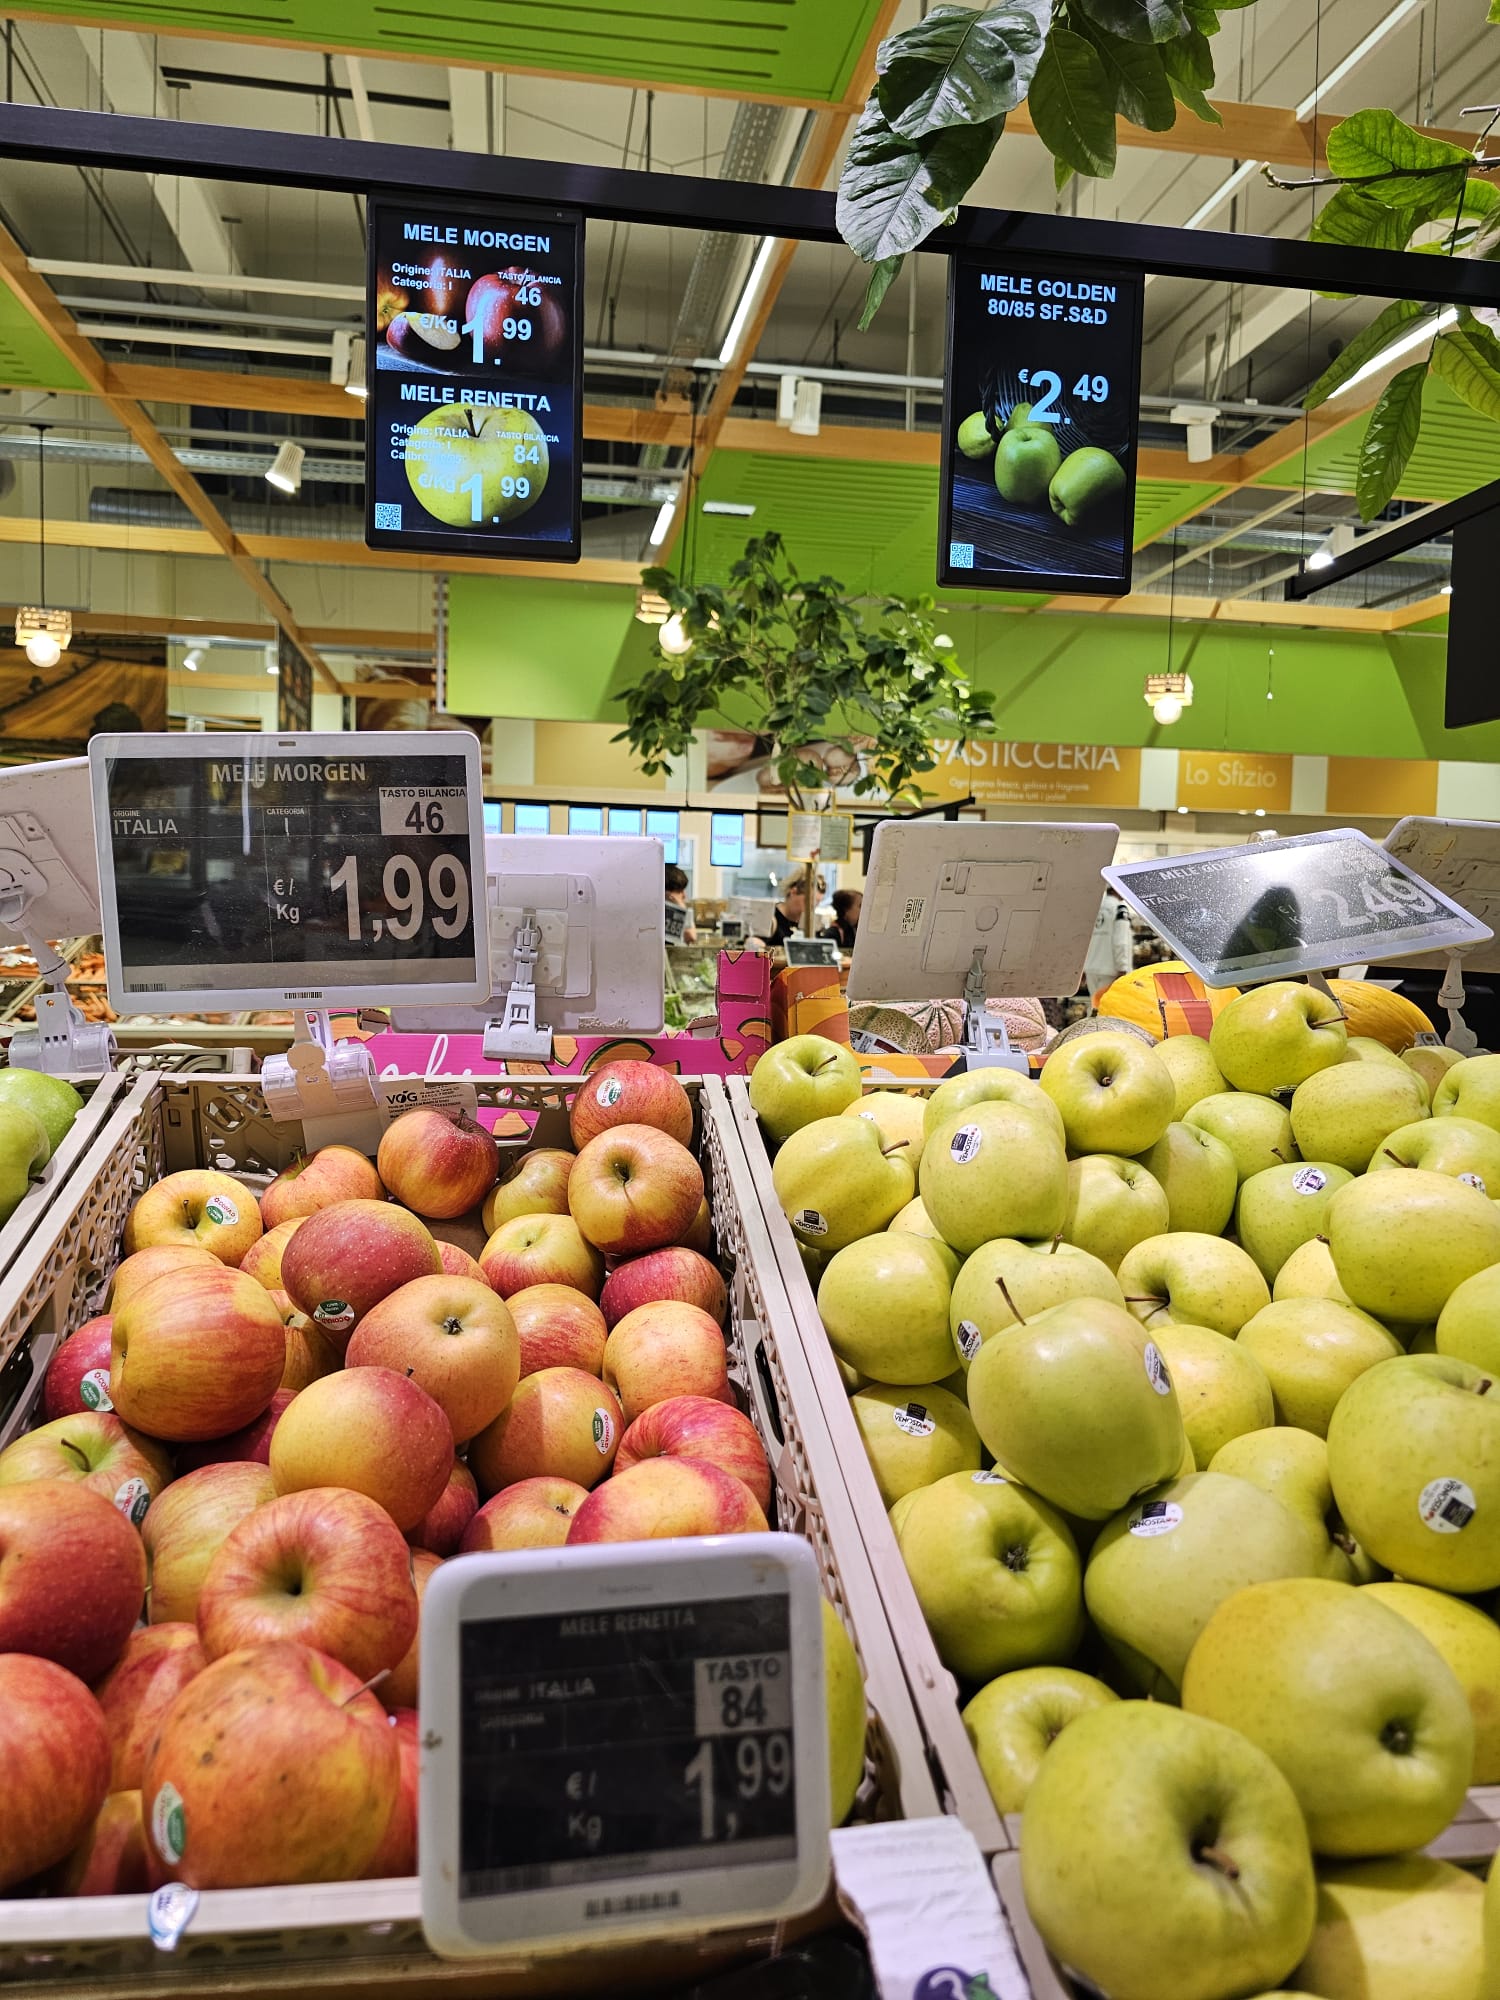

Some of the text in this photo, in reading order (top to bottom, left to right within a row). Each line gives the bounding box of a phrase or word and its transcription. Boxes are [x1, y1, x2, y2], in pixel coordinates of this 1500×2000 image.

[404, 223, 550, 253] MELE MORGEN
[392, 263, 471, 279] Origine: ITALIA
[498, 271, 562, 285] TASTO BILANCIA
[392, 275, 446, 290] Categoria:
[980, 274, 1116, 303] MELE GOLDEN
[515, 286, 541, 306] 46
[988, 298, 1107, 325] 80/85 SF.S&D
[419, 314, 458, 335] €/Kg
[502, 318, 532, 341] 99
[401, 384, 551, 412] MELE RENETTA
[1073, 374, 1109, 402] 49
[390, 423, 470, 439] Origine: ITALIA
[496, 430, 560, 444] TASTO BILANCIA
[513, 444, 539, 464] 84
[418, 473, 456, 493] €/Kg
[501, 477, 530, 499] 99
[211, 763, 366, 783] MELE MORGEN
[1185, 760, 1277, 787] Lo Sfizio
[380, 788, 466, 799] TASTO BILANCIA
[113, 810, 140, 818] ORIGINE
[405, 801, 444, 834] 46
[114, 819, 178, 835] ITALIA
[1158, 865, 1199, 881] MELE
[330, 854, 470, 943] 1,99
[1142, 893, 1192, 906] ITALIA
[1309, 876, 1436, 928] 2,49
[276, 904, 299, 923] Kg
[960, 1135, 974, 1161] VENOSTA
[218, 1201, 236, 1217] CONAD
[322, 1316, 344, 1325] CONAD
[895, 1415, 923, 1429] VENOSTA
[122, 1484, 135, 1513] CONAD
[560, 1608, 696, 1637] MELE RENETTA
[705, 1658, 780, 1682] TASTO
[529, 1677, 596, 1699] ITALIA
[722, 1684, 767, 1728] 84
[567, 1811, 602, 1842] Kg
